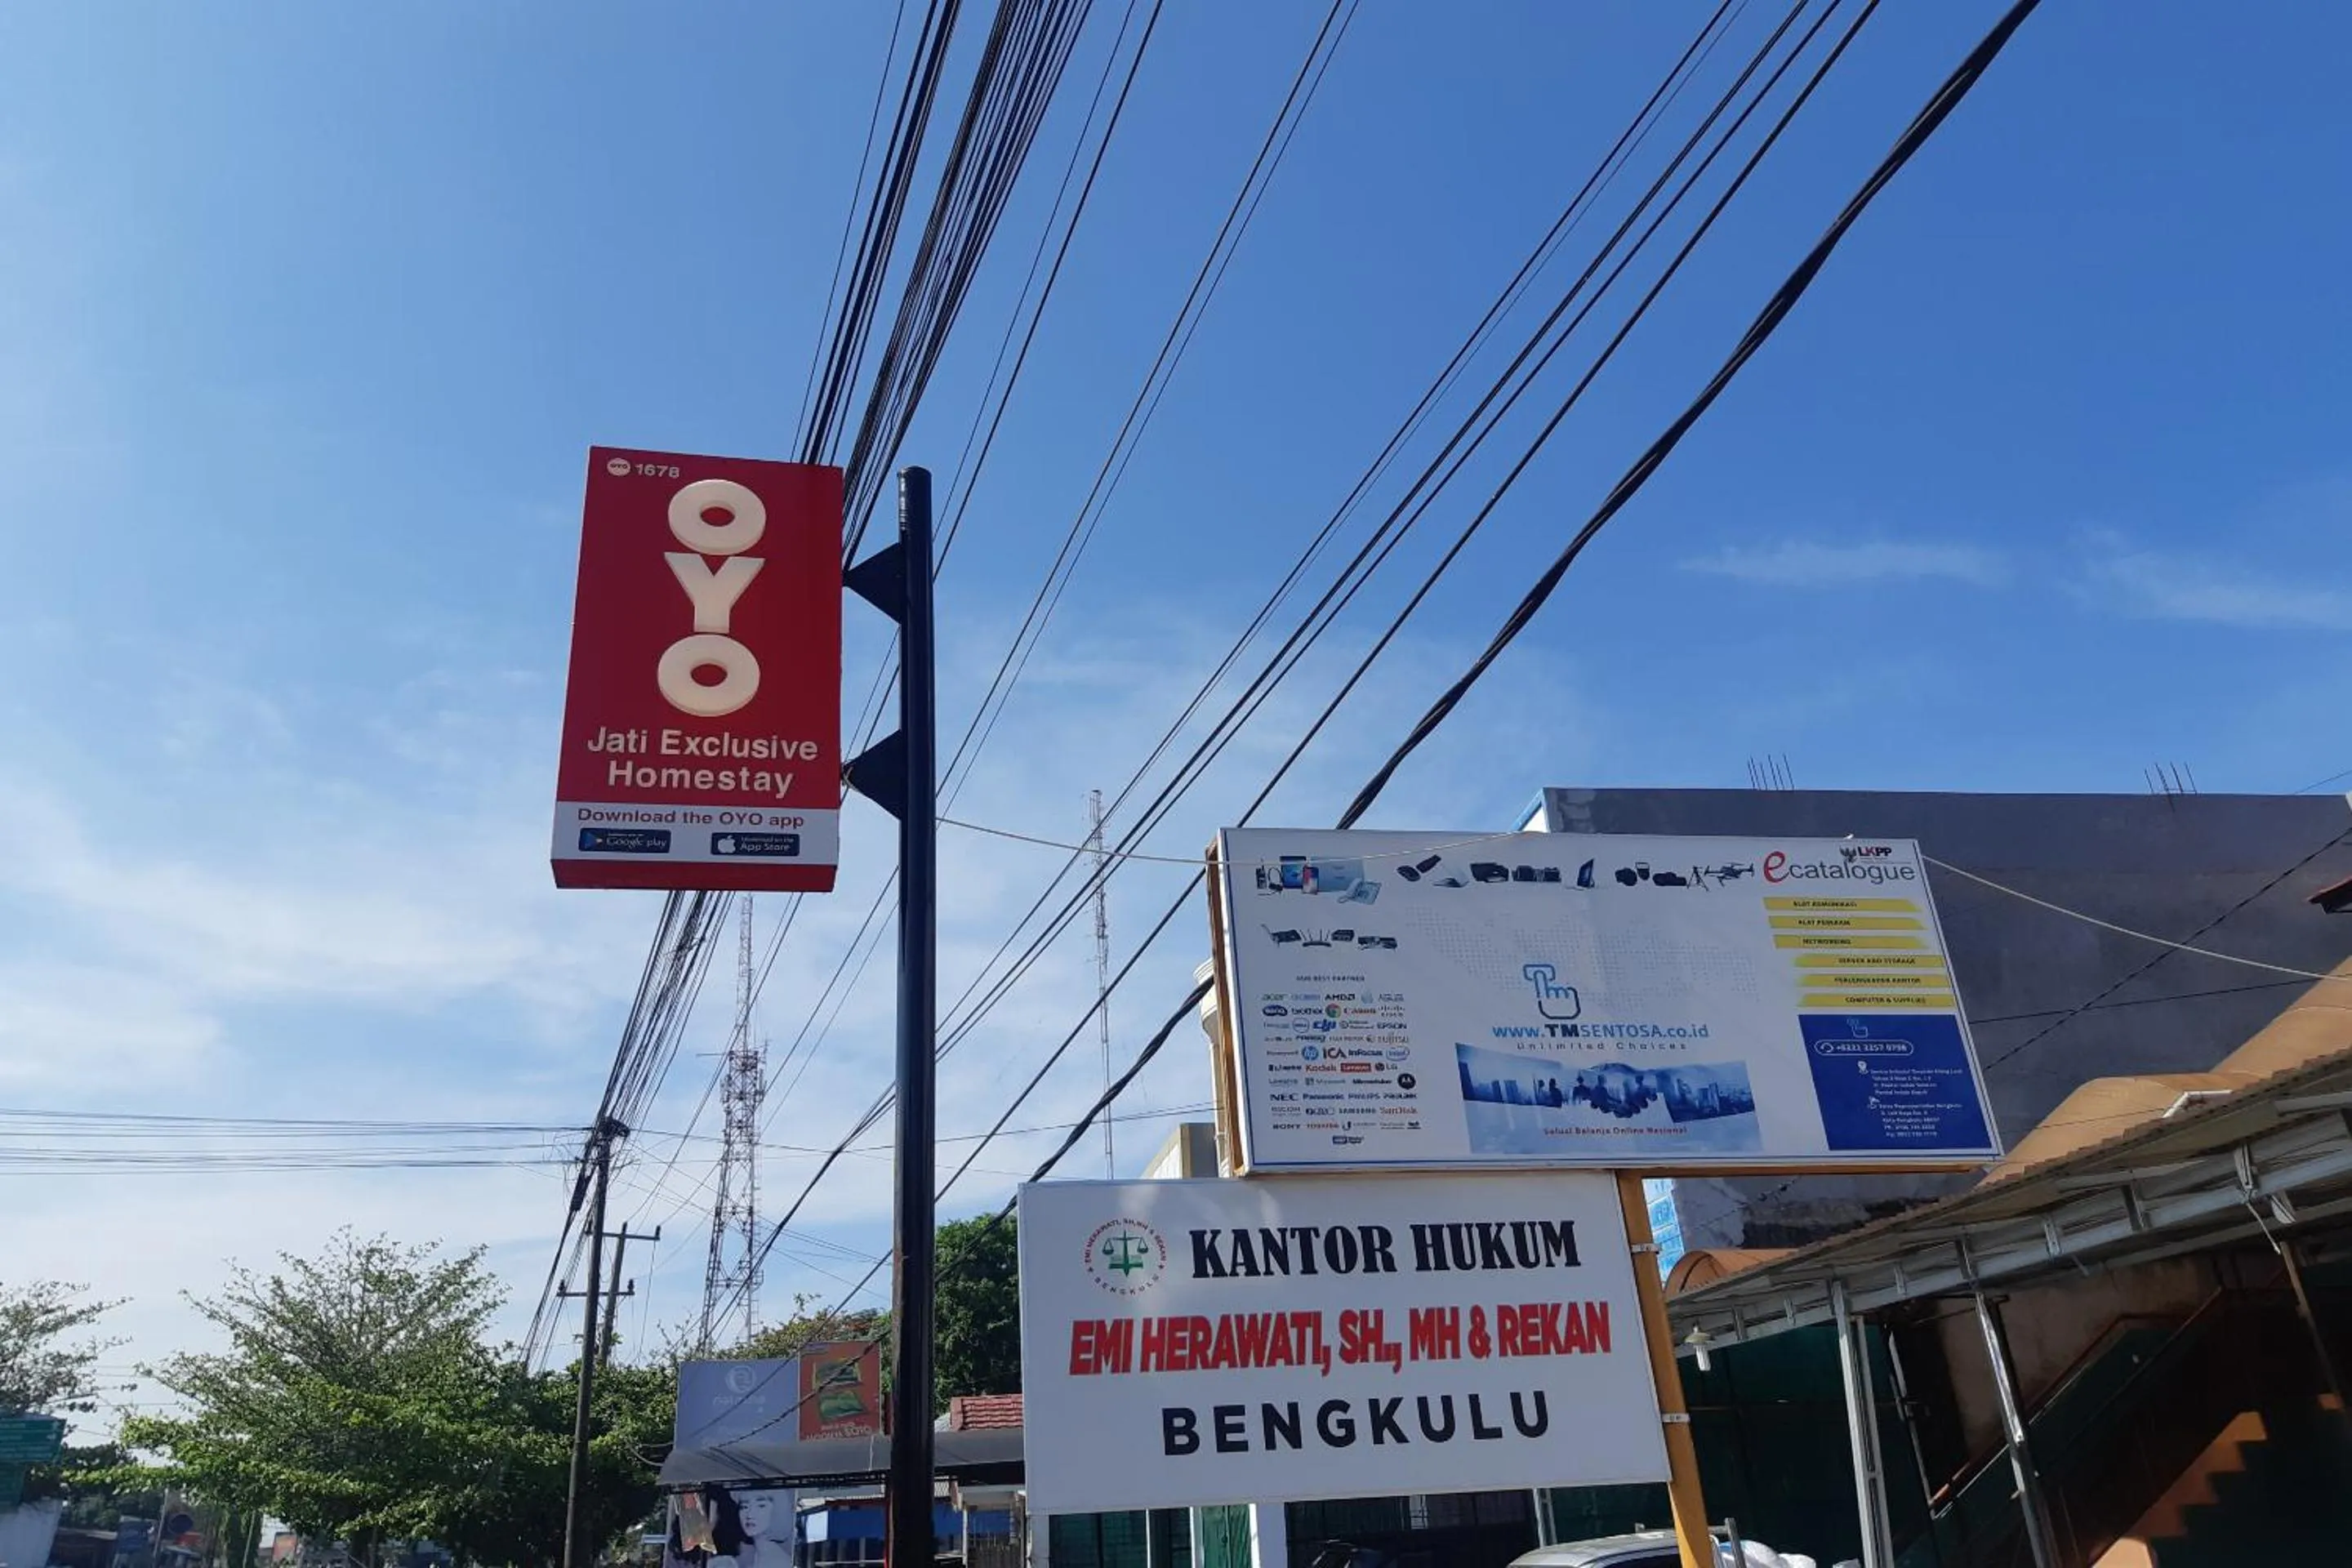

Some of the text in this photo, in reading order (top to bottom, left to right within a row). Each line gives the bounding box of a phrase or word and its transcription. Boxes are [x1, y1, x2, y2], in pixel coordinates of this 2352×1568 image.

[635, 463, 680, 479] 1678
[657, 479, 766, 717] OYO
[587, 727, 817, 761] Jati Exclusive
[607, 760, 793, 799] Homestay
[577, 808, 804, 829] Download the OYO app
[606, 835, 644, 849] Google
[739, 841, 791, 852] App Store
[1857, 846, 1892, 857] LKPP
[1325, 993, 1347, 1001] AMD
[1492, 1023, 1709, 1038] www.TMSENTOSA.co.id
[1323, 1047, 1347, 1059] ICA
[1517, 1041, 1687, 1051] Unlimited Choices
[1270, 1094, 1298, 1102] NEC
[1613, 1127, 1644, 1135] Online
[1189, 1219, 1581, 1279] KANTOR HUKUM
[1069, 1301, 1611, 1378] EMI HERAWATI, SH., MH & REKAN
[1161, 1390, 1549, 1456] BENGKULU
